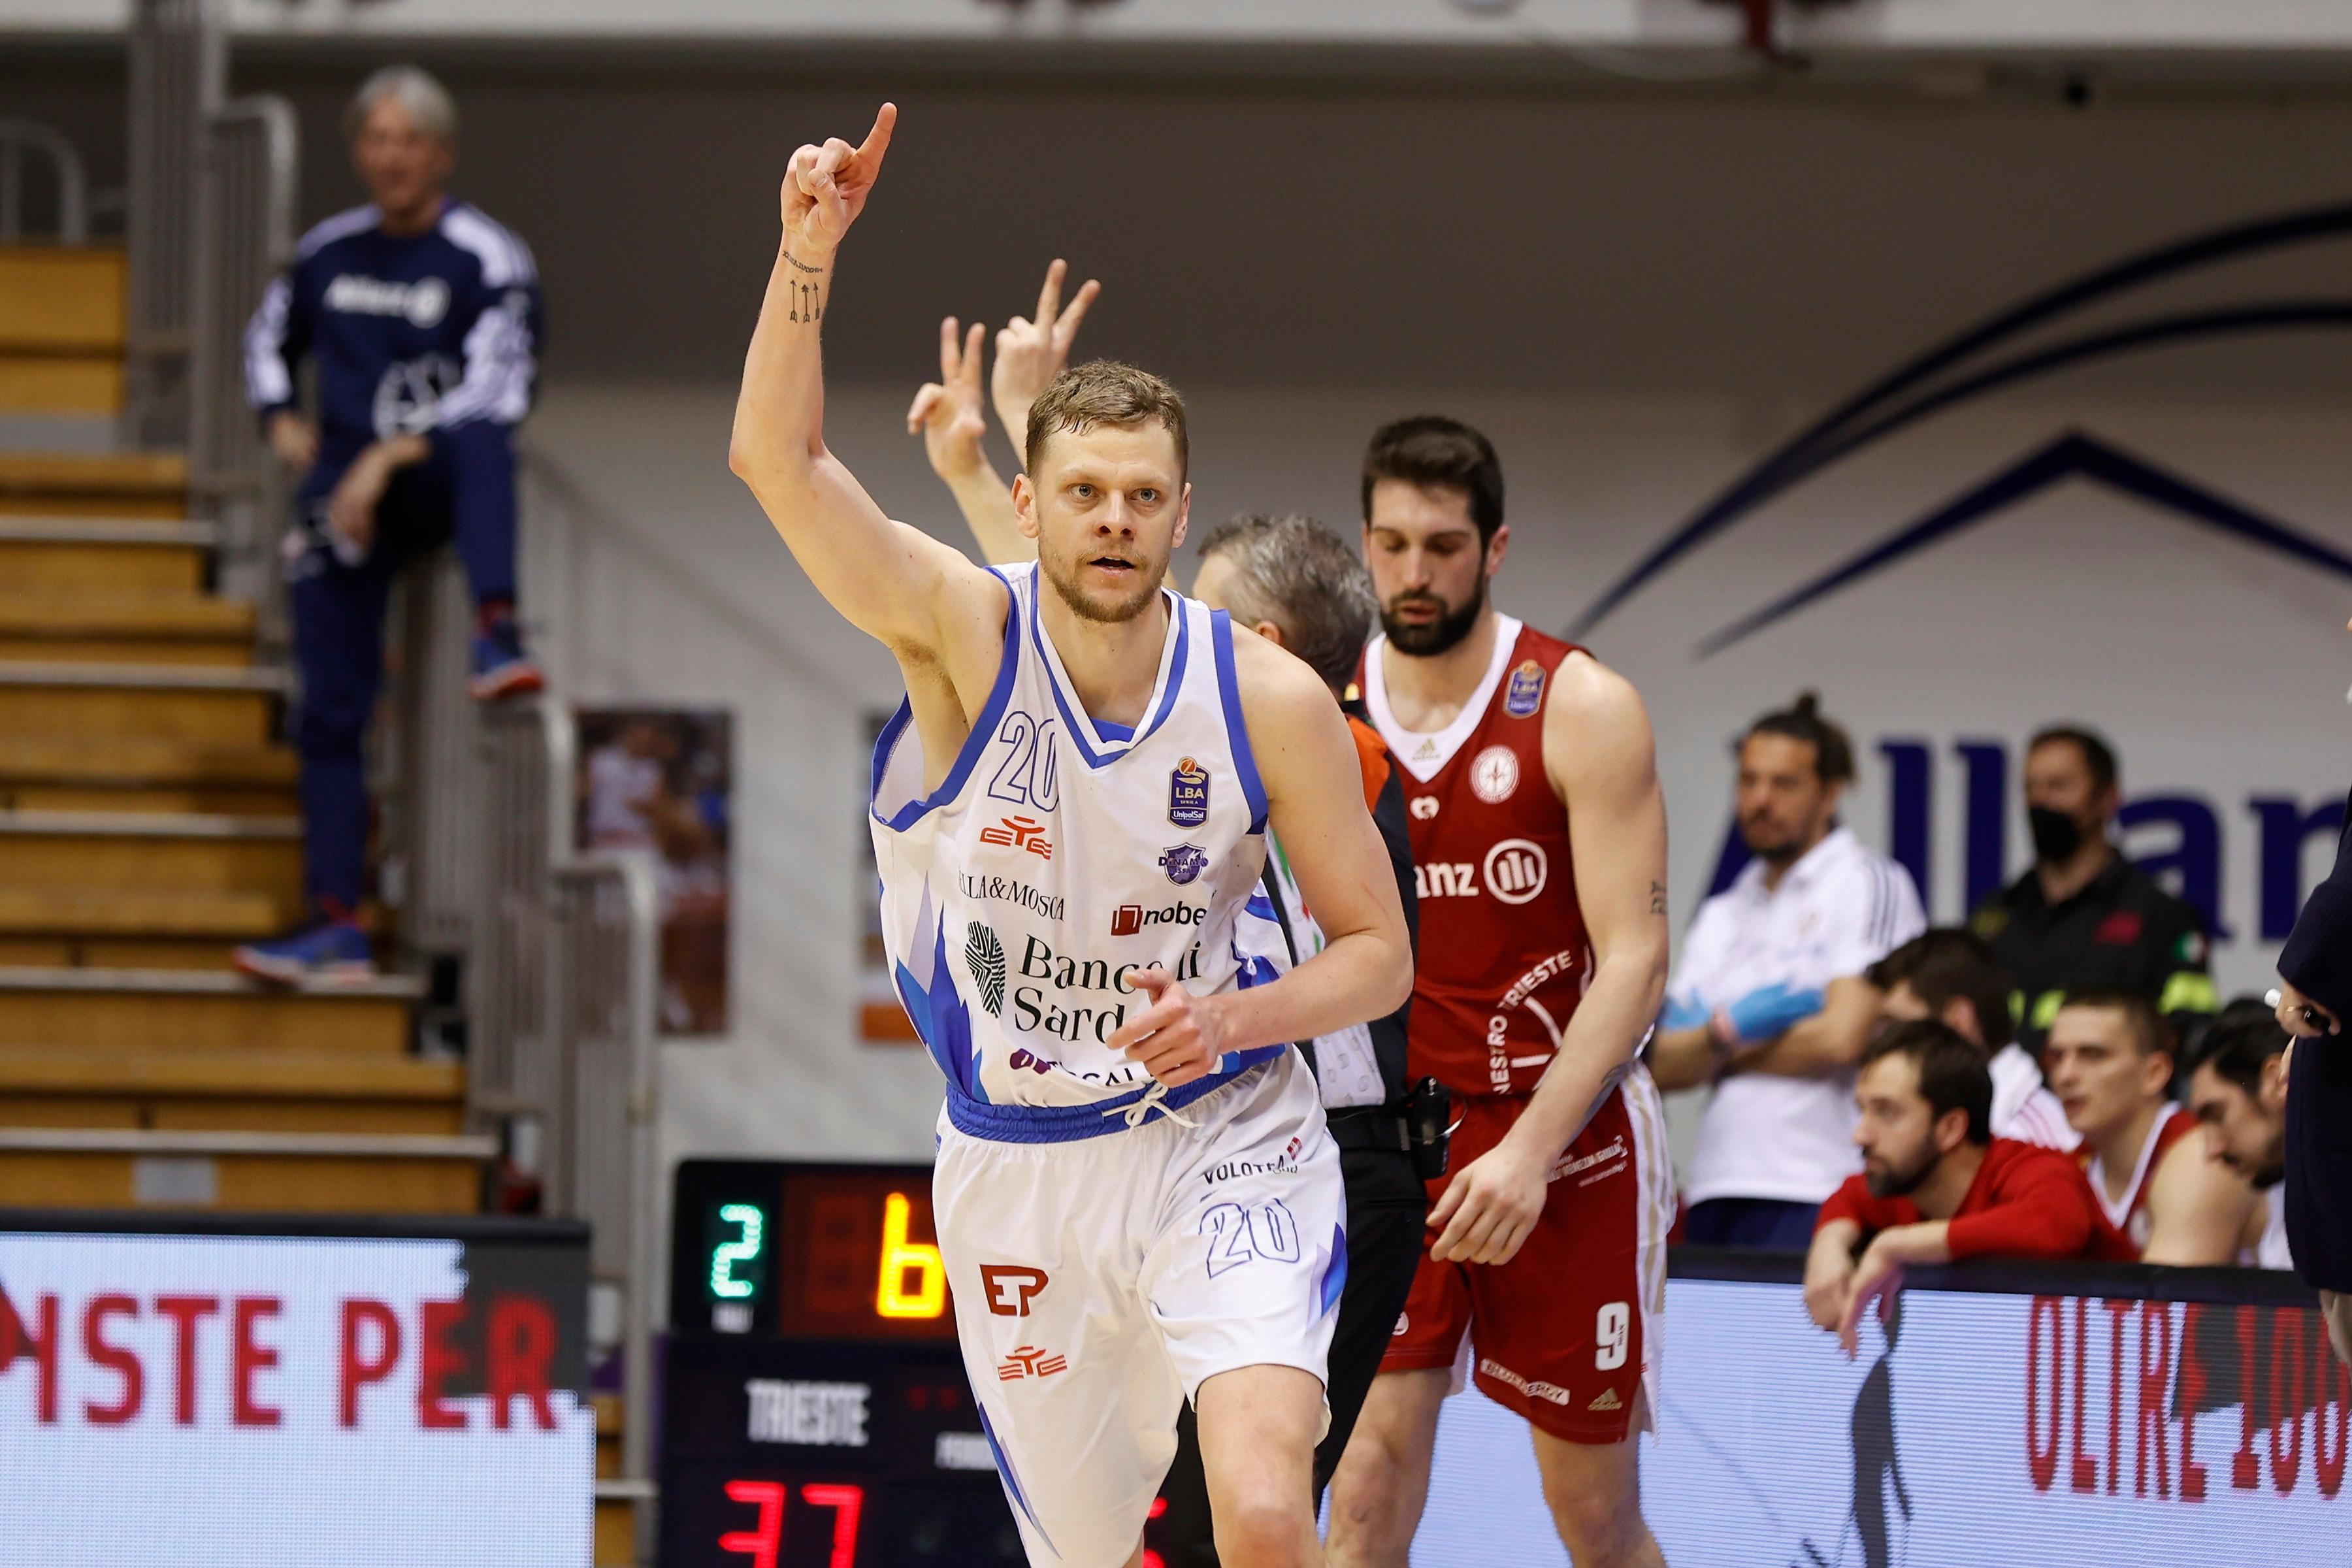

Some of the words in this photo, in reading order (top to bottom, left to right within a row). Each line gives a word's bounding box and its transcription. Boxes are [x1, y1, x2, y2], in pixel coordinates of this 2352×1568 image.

[987, 710, 1059, 812] 20
[1176, 787, 1205, 799] LBA
[958, 870, 1064, 922] LLA&MOSCA
[1143, 901, 1207, 926] nobe
[1018, 934, 1163, 994] Banc
[710, 1203, 763, 1298] 2
[877, 1192, 947, 1318] 6
[1199, 1198, 1300, 1279] 20
[979, 1264, 1049, 1317] EP
[338, 1296, 559, 1429] PER
[1595, 1301, 1629, 1371] 9
[745, 1379, 871, 1446] TRIESTE
[2027, 1295, 2207, 1503] OLTRE
